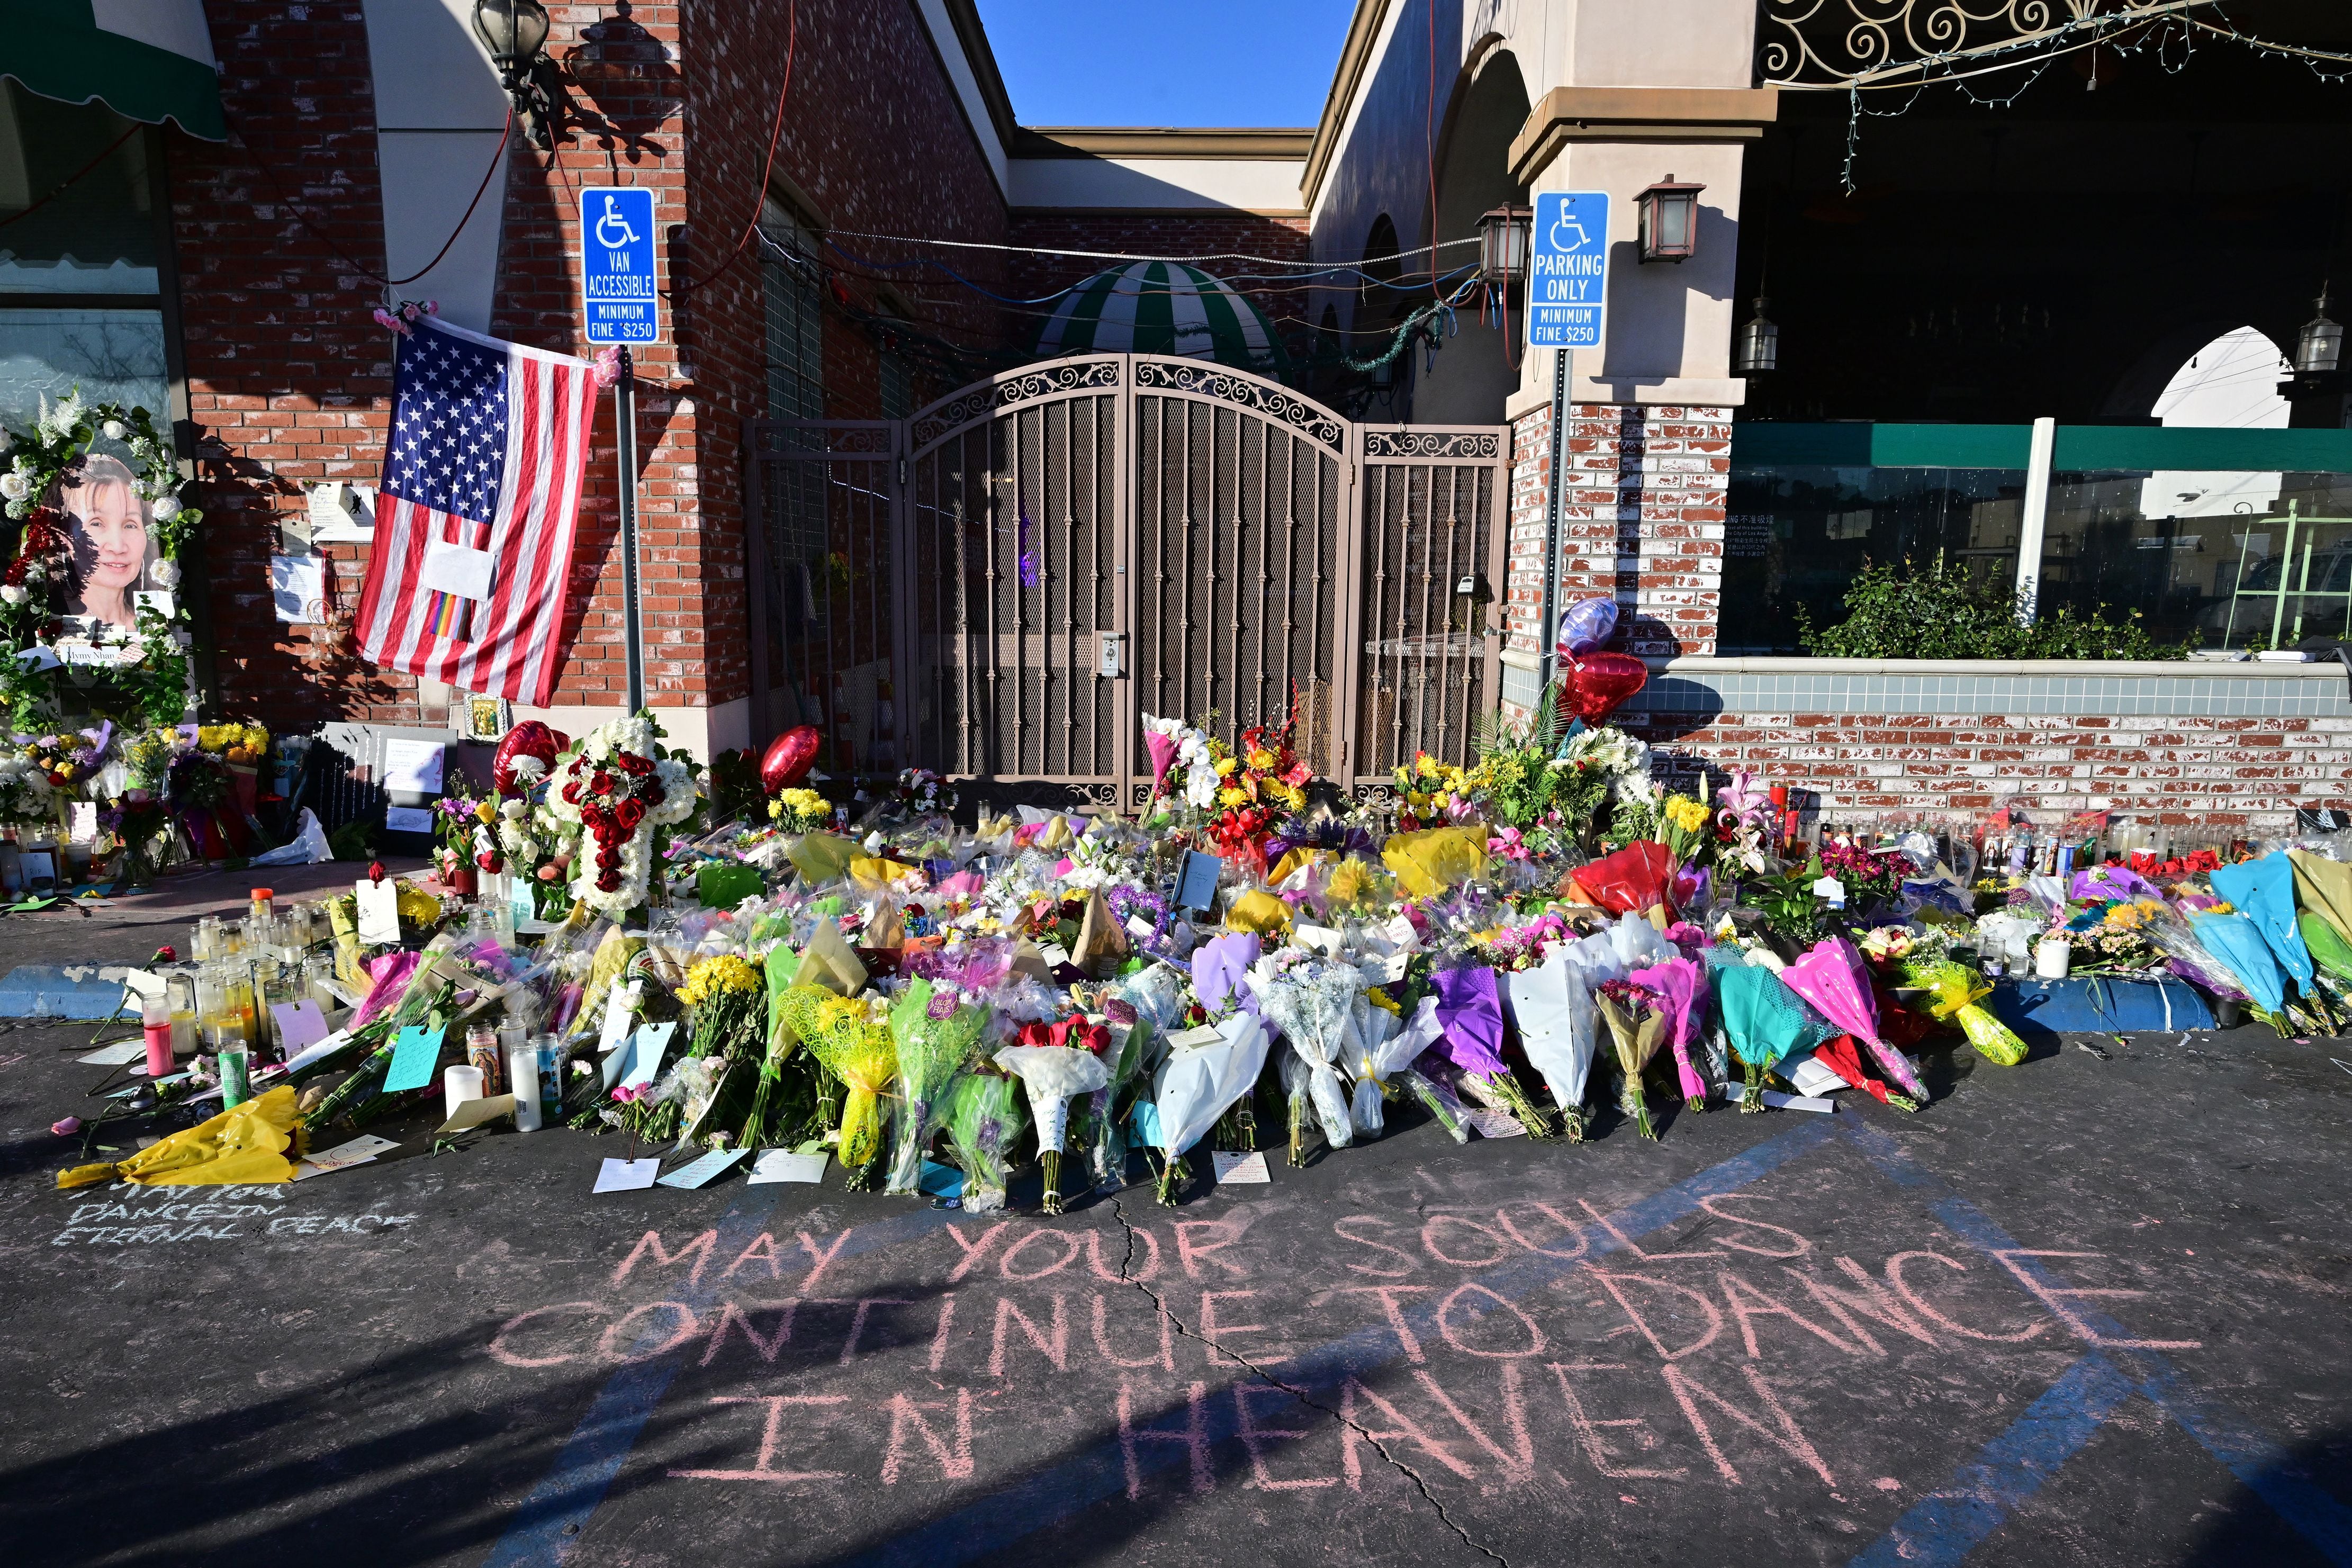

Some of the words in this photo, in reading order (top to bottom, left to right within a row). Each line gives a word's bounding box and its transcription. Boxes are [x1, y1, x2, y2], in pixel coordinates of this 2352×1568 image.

[609, 251, 630, 272] VAN
[1536, 255, 1602, 275] PARKING
[589, 275, 652, 296] ACCESSIBLE
[1547, 280, 1589, 300] ONLY
[598, 305, 644, 319] MINIMUM
[1540, 309, 1592, 323] MINIMUM
[591, 322, 614, 337] FINE
[623, 321, 652, 338] $250
[1536, 327, 1562, 341] FINE
[1566, 326, 1594, 343] $250
[67, 651, 92, 661] Mymy
[93, 651, 115, 660] Nhan
[1389, 930, 1408, 940] RONG
[1111, 1004, 1132, 1014] BLOOM
[1111, 1009, 1132, 1020] HAUS
[65, 1201, 222, 1225] DANCE
[50, 1222, 245, 1246] ETERNAL
[609, 1227, 854, 1293] MAY
[945, 1220, 1254, 1283] YOUR
[1333, 1192, 1821, 1277] SOULS
[488, 1290, 1292, 1376] CONTINUE
[1339, 1282, 1548, 1364] TO
[1585, 1249, 2203, 1360] DANCE
[666, 1383, 977, 1485] IN
[1116, 1358, 1837, 1501] HEAVEN
